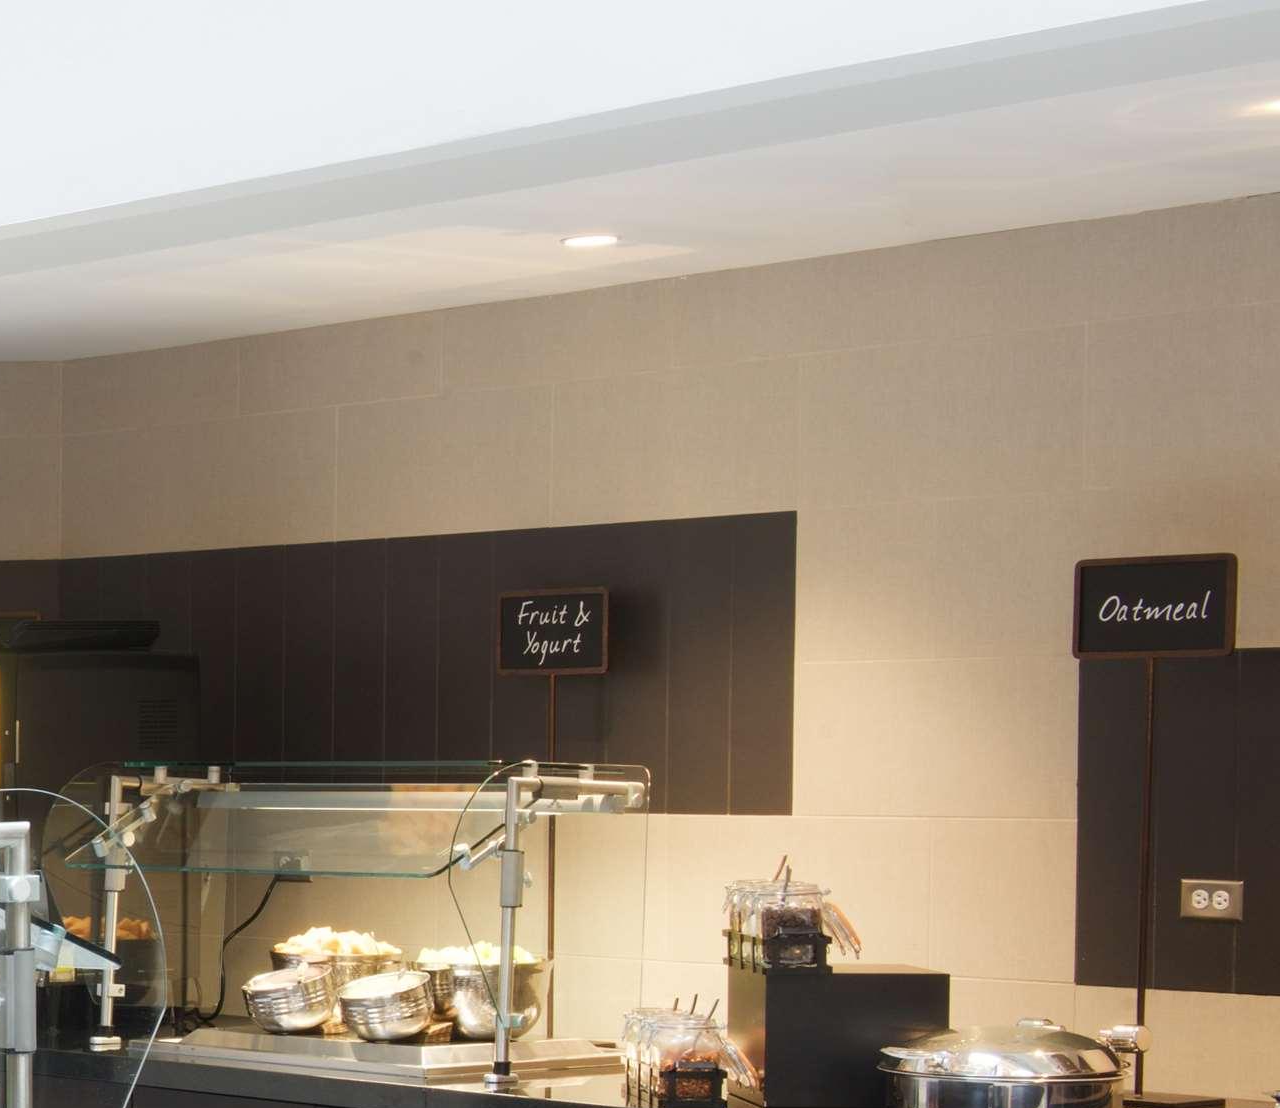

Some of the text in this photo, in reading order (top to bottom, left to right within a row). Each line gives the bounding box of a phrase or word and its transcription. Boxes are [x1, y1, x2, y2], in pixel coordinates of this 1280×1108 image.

[519, 601, 590, 626] Fruit &
[1099, 591, 1210, 621] Oatmeal
[524, 631, 581, 665] Yogurt
